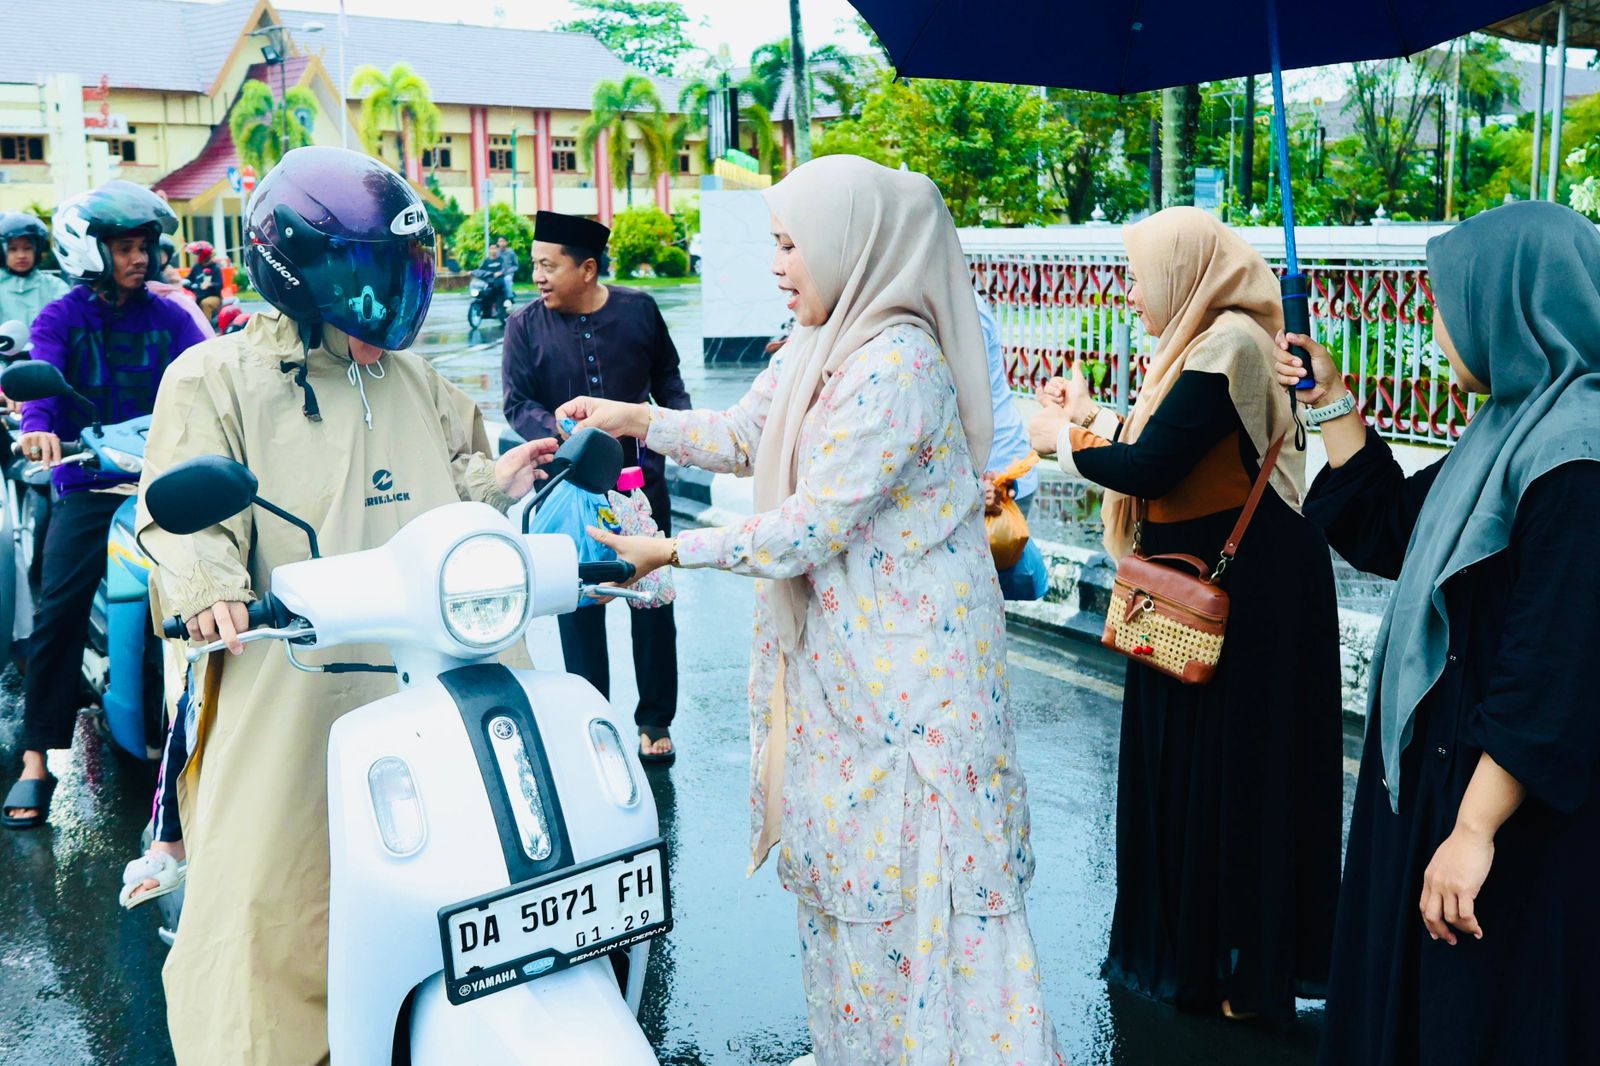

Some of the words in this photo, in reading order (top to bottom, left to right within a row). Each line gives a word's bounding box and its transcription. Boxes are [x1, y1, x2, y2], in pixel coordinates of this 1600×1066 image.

[458, 914, 501, 953] DA
[521, 883, 598, 933] 5071
[618, 864, 654, 903] FH
[569, 942, 619, 964] SEMAKIN
[618, 936, 631, 948] DI
[630, 925, 668, 944] DEPAN
[471, 968, 518, 992] YAMAHA
